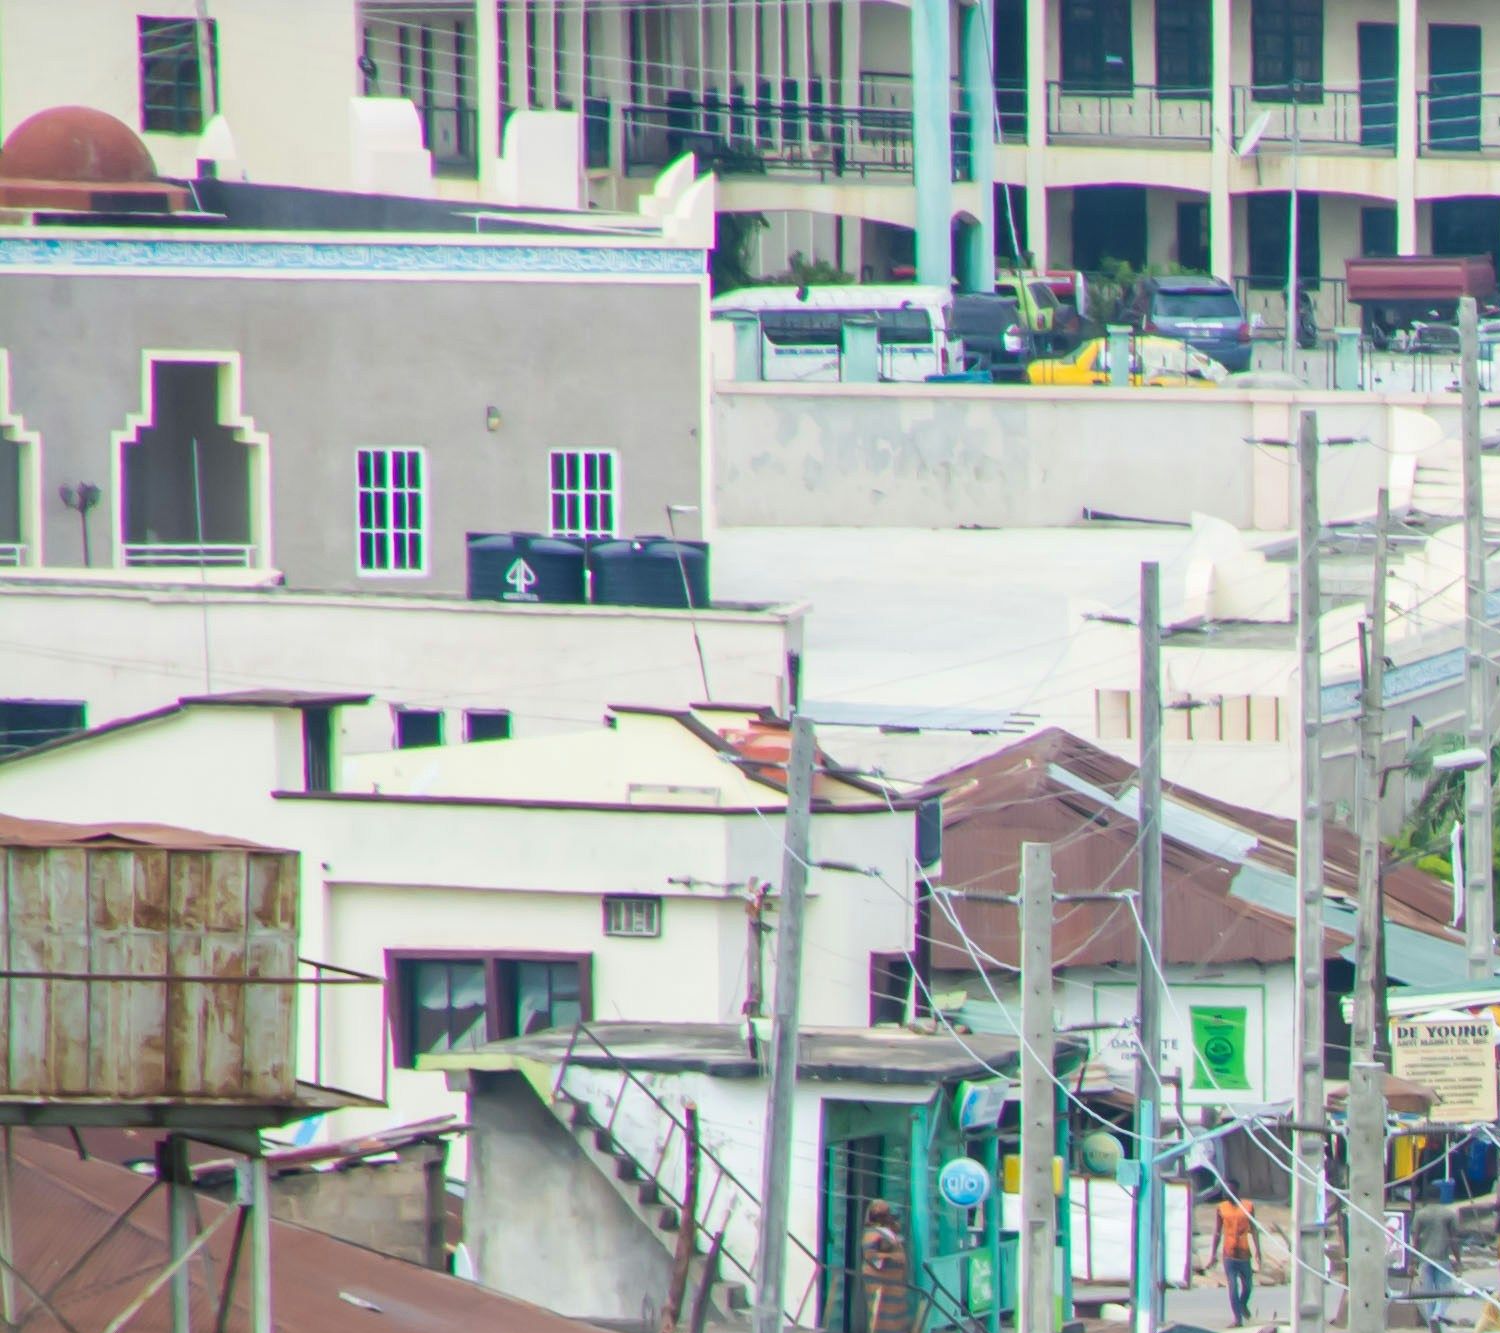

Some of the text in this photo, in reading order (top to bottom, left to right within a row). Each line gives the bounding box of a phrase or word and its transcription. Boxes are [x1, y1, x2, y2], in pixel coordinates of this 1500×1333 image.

[1397, 1025, 1489, 1039] DE YOUNG
[1111, 1039, 1179, 1050] DANTE
[946, 1173, 978, 1195] glo
